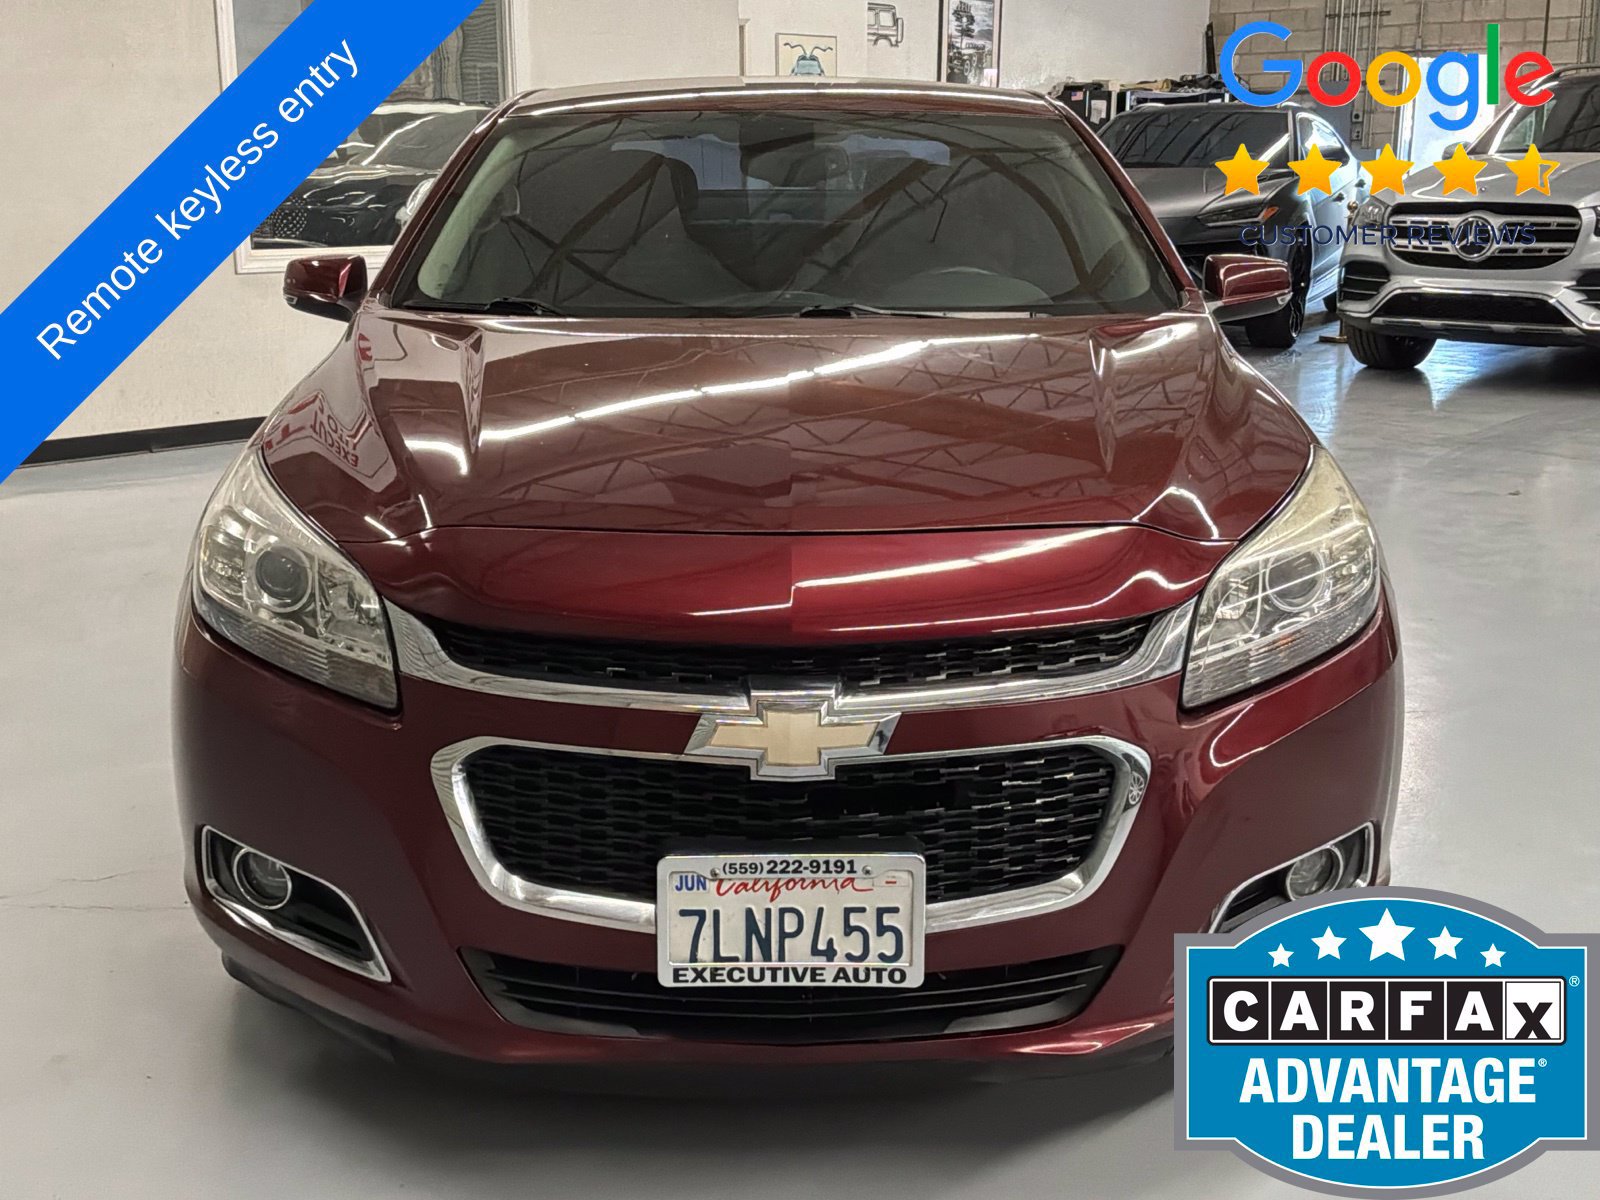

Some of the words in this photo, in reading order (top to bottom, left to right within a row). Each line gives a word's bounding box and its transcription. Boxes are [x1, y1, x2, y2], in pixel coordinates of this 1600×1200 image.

[722, 861, 764, 876] (559)
[766, 859, 857, 875] 222-9191
[674, 874, 708, 892] JUN
[715, 876, 874, 903] California
[678, 906, 904, 964] 7LNP455
[672, 966, 828, 984] EXECUTIVE
[831, 966, 908, 984] AUTO
